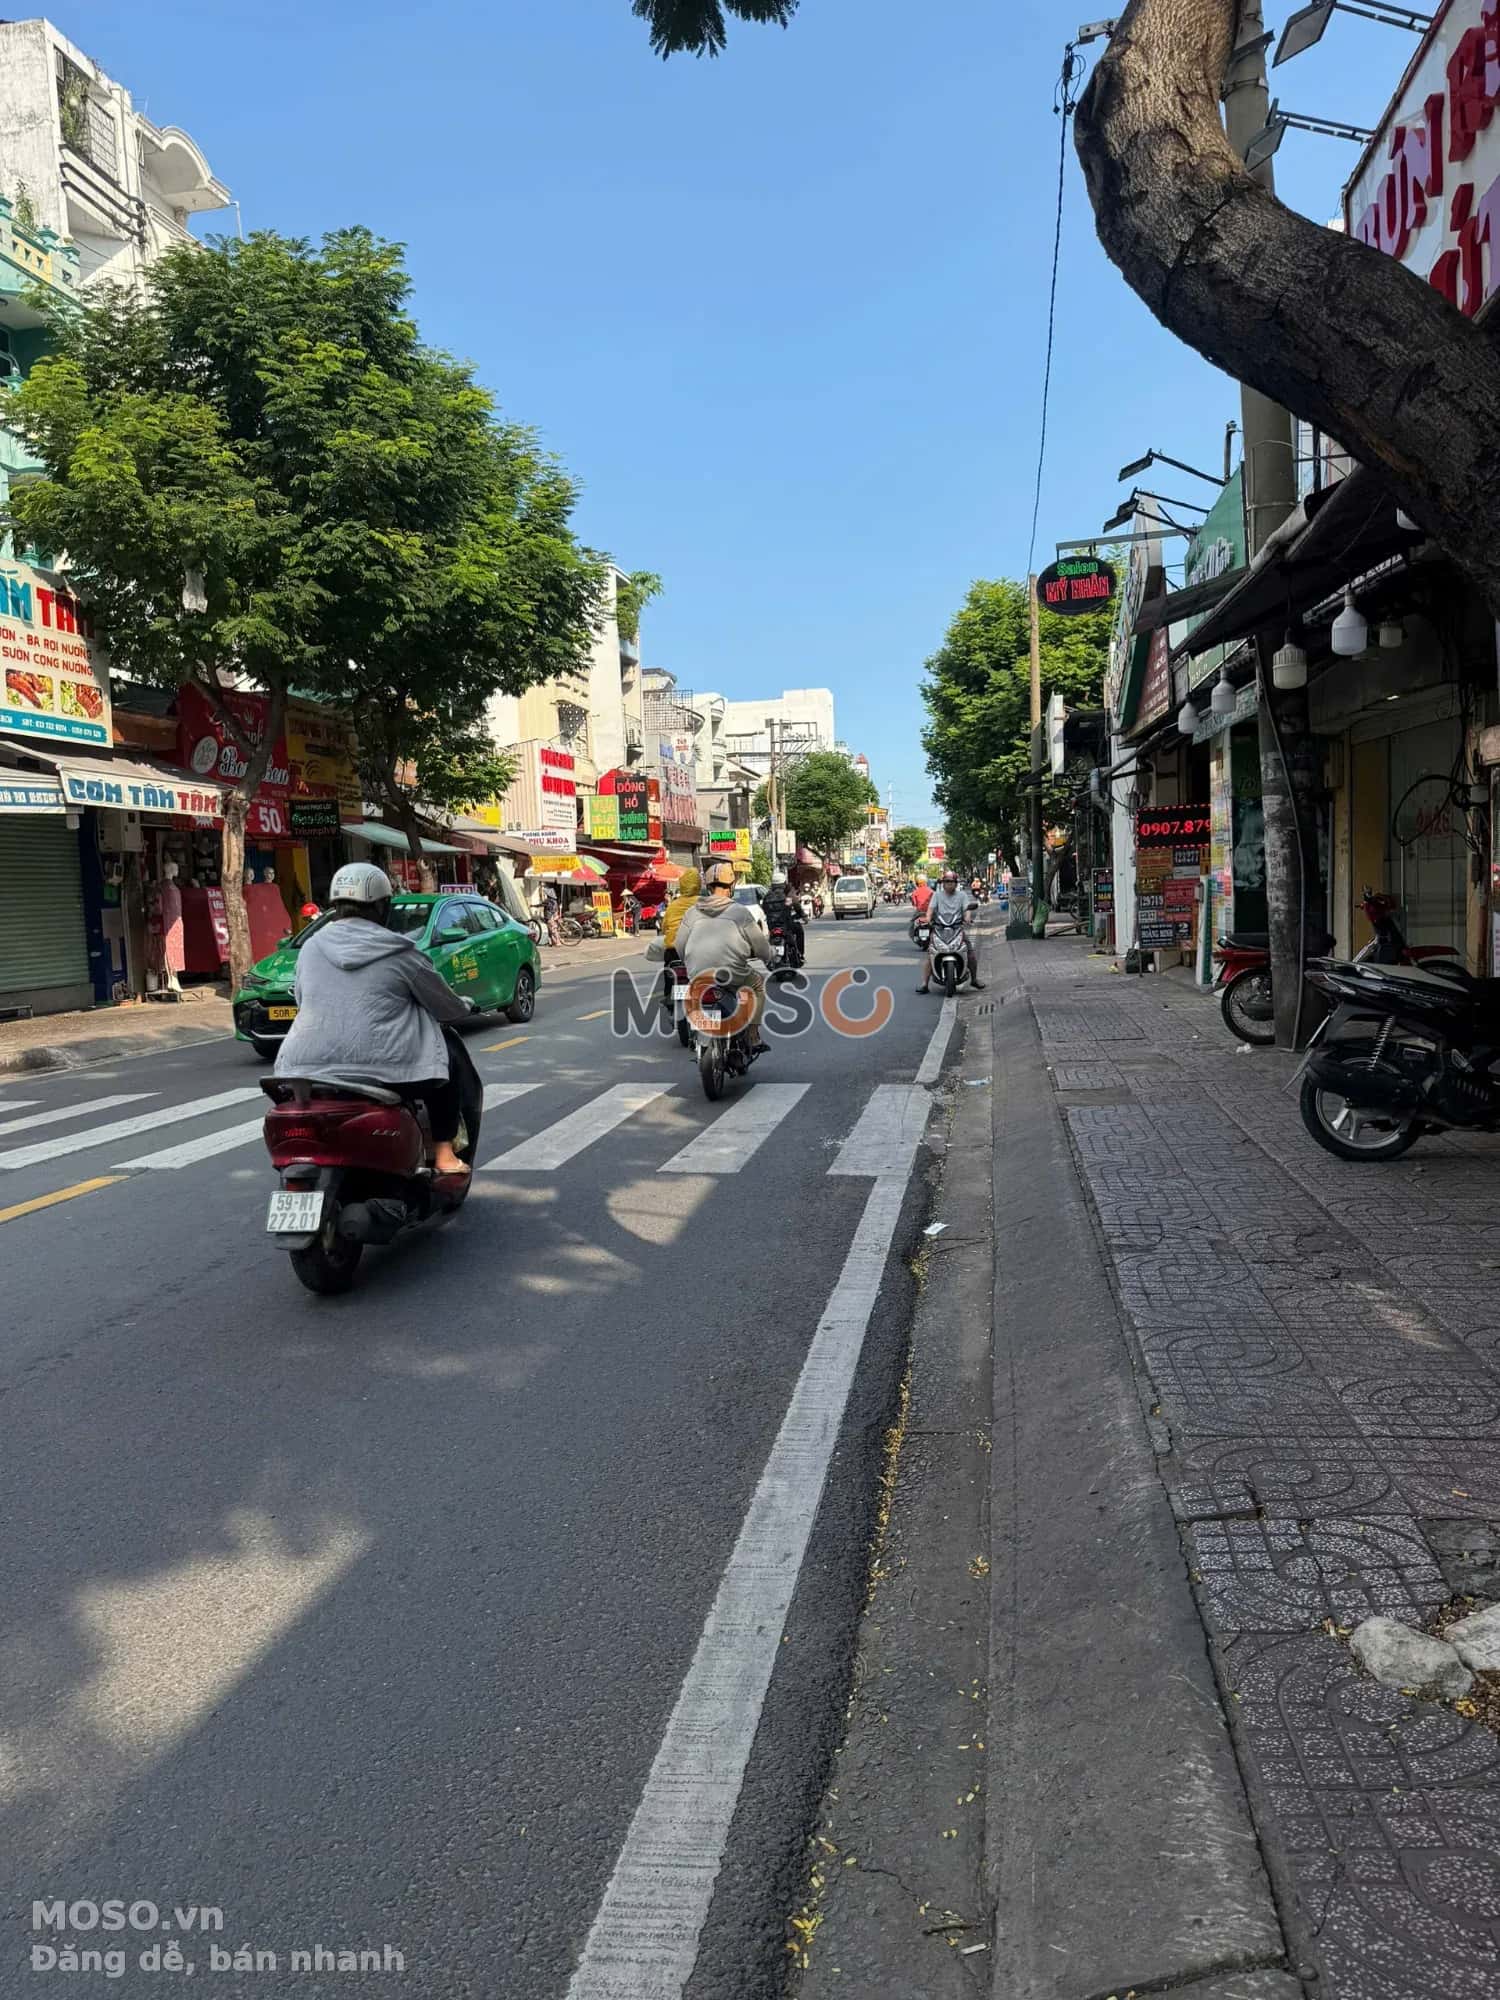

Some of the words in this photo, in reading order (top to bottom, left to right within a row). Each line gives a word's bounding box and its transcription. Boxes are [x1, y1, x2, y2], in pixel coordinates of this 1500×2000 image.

[1057, 561, 1098, 576] Salon
[68, 778, 123, 804] CƠM
[177, 788, 218, 814] TÂM
